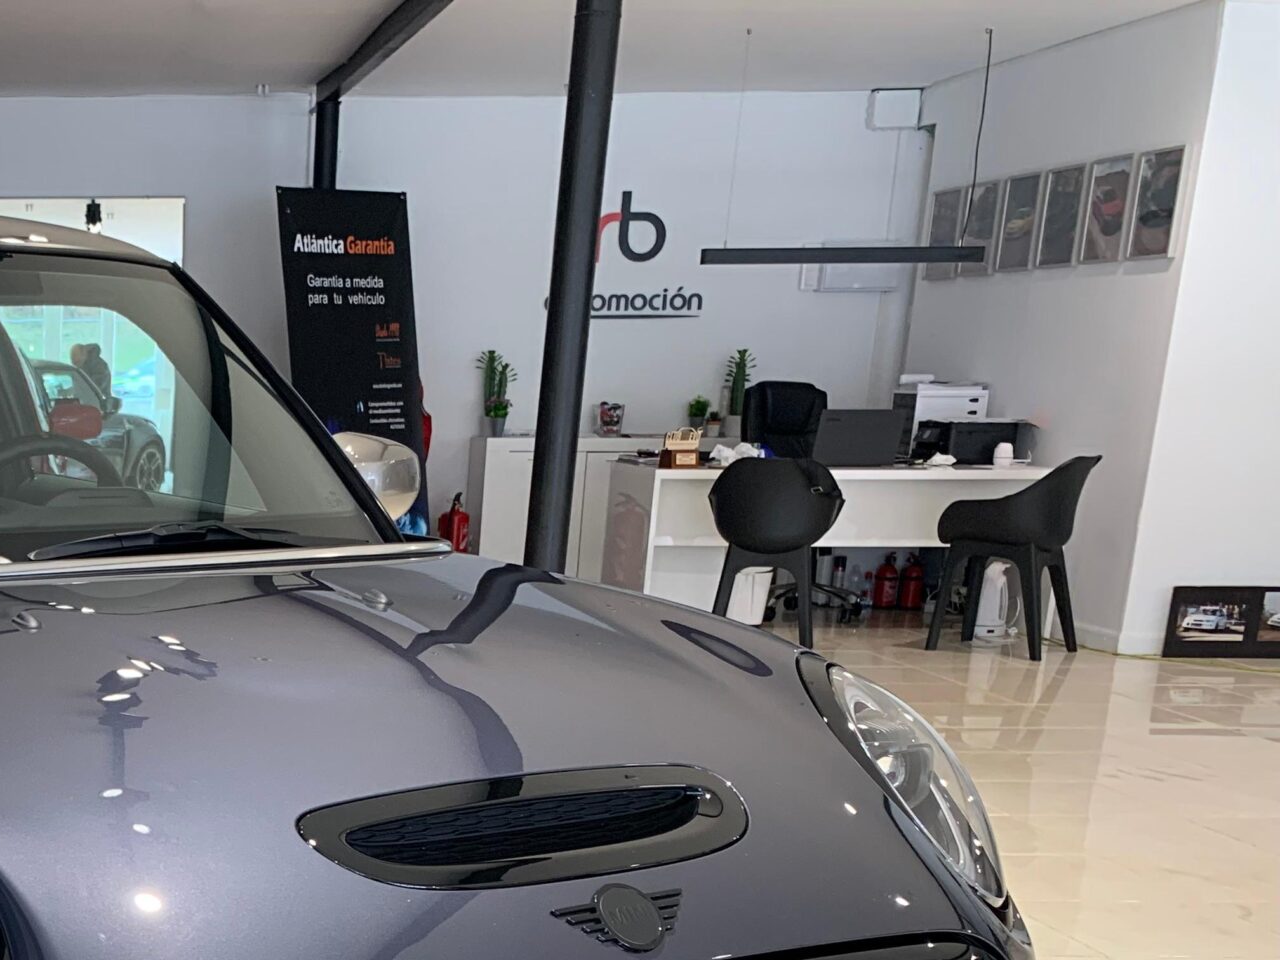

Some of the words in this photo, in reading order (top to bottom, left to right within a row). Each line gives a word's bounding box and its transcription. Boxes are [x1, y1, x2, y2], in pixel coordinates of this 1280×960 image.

[294, 233, 345, 254] Atlántica
[345, 277, 351, 288] a
[353, 275, 384, 288] medida
[308, 293, 328, 307] para
[333, 292, 342, 304] tu
[544, 286, 703, 312] omoción
